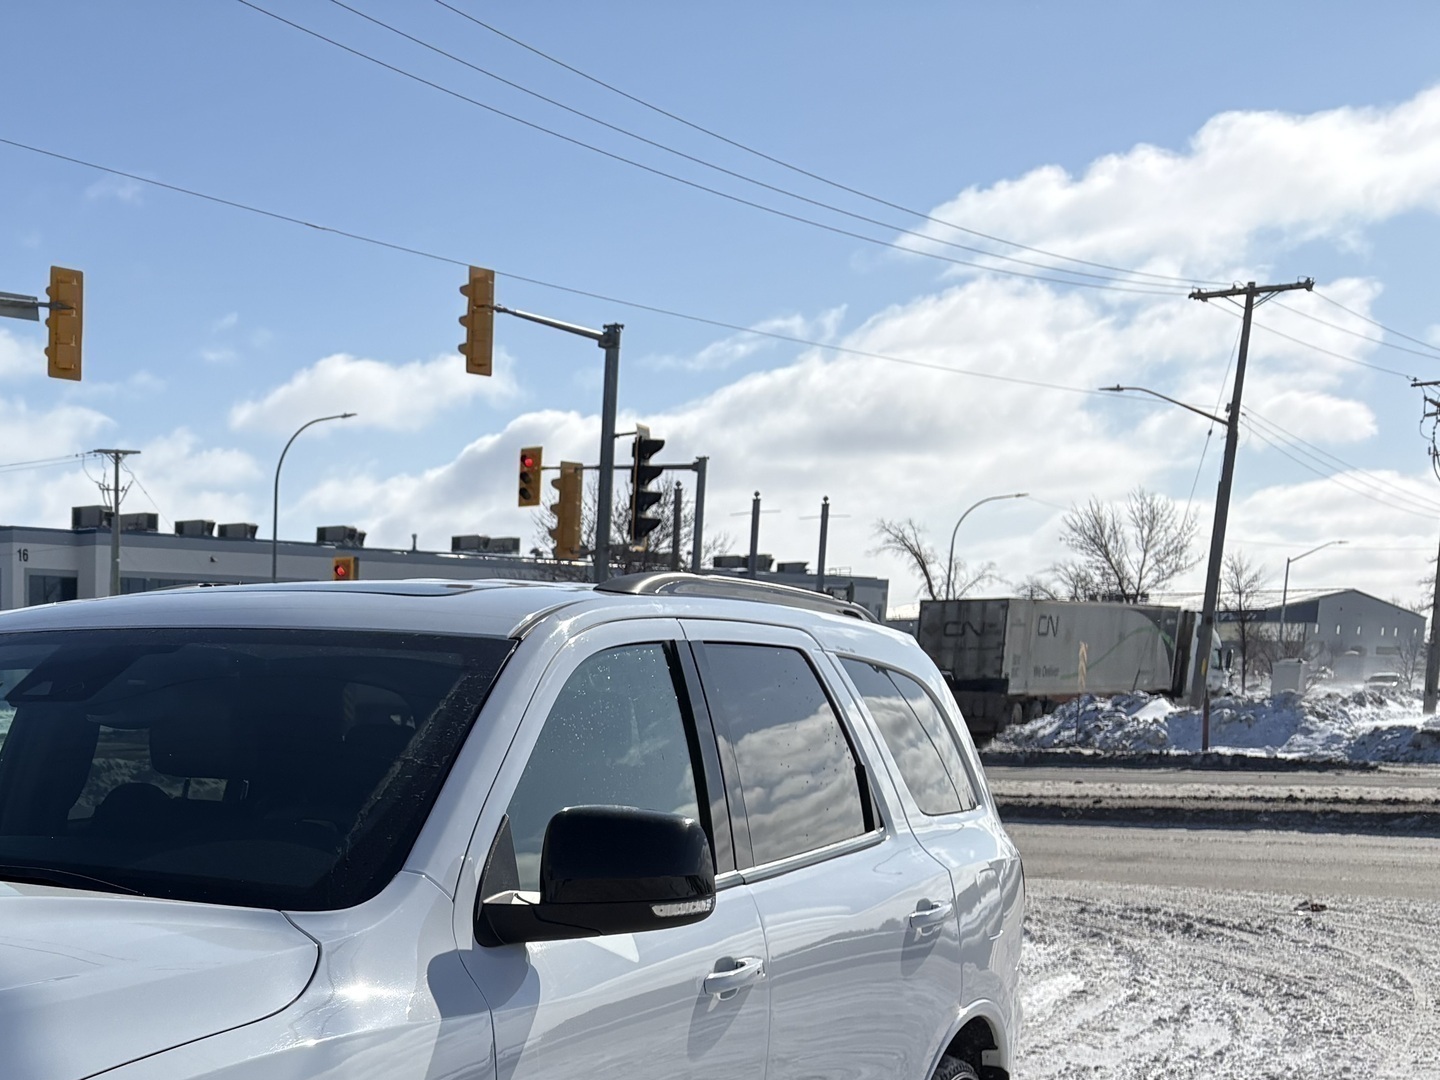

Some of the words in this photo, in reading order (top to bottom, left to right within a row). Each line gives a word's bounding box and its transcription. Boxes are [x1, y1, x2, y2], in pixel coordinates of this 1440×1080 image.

[17, 548, 29, 562] 16
[943, 621, 985, 638] CN
[1037, 615, 1060, 638] CN
